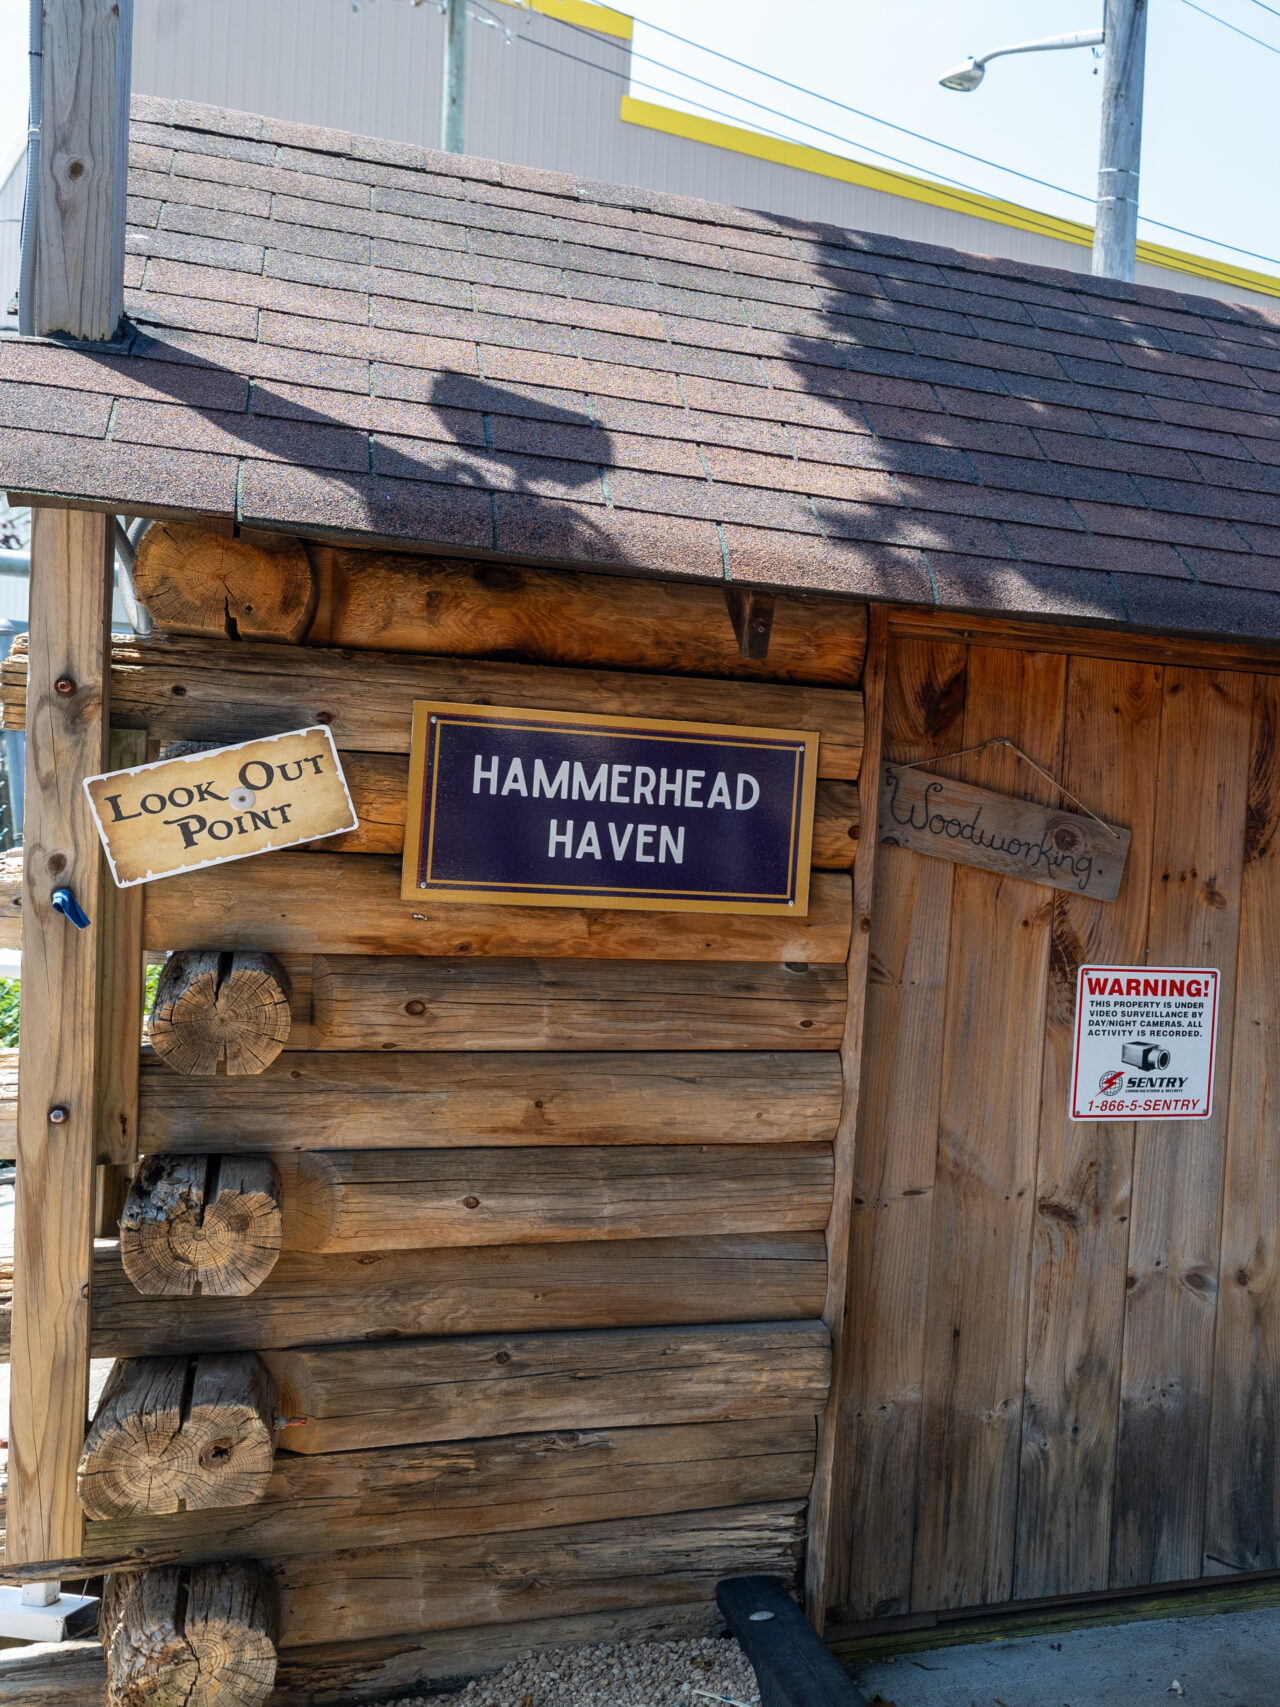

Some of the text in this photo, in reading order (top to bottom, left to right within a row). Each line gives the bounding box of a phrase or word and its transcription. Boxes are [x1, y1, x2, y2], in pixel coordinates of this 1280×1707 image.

[472, 754, 760, 810] HAMMERHEAD
[548, 819, 685, 864] HAVEN
[1087, 977, 1209, 998] WARNING!
[1090, 1000, 1111, 1008] THIS
[1126, 1077, 1188, 1088] SENTRY
[1088, 1099, 1200, 1112] 1-866-5-SENTRY
